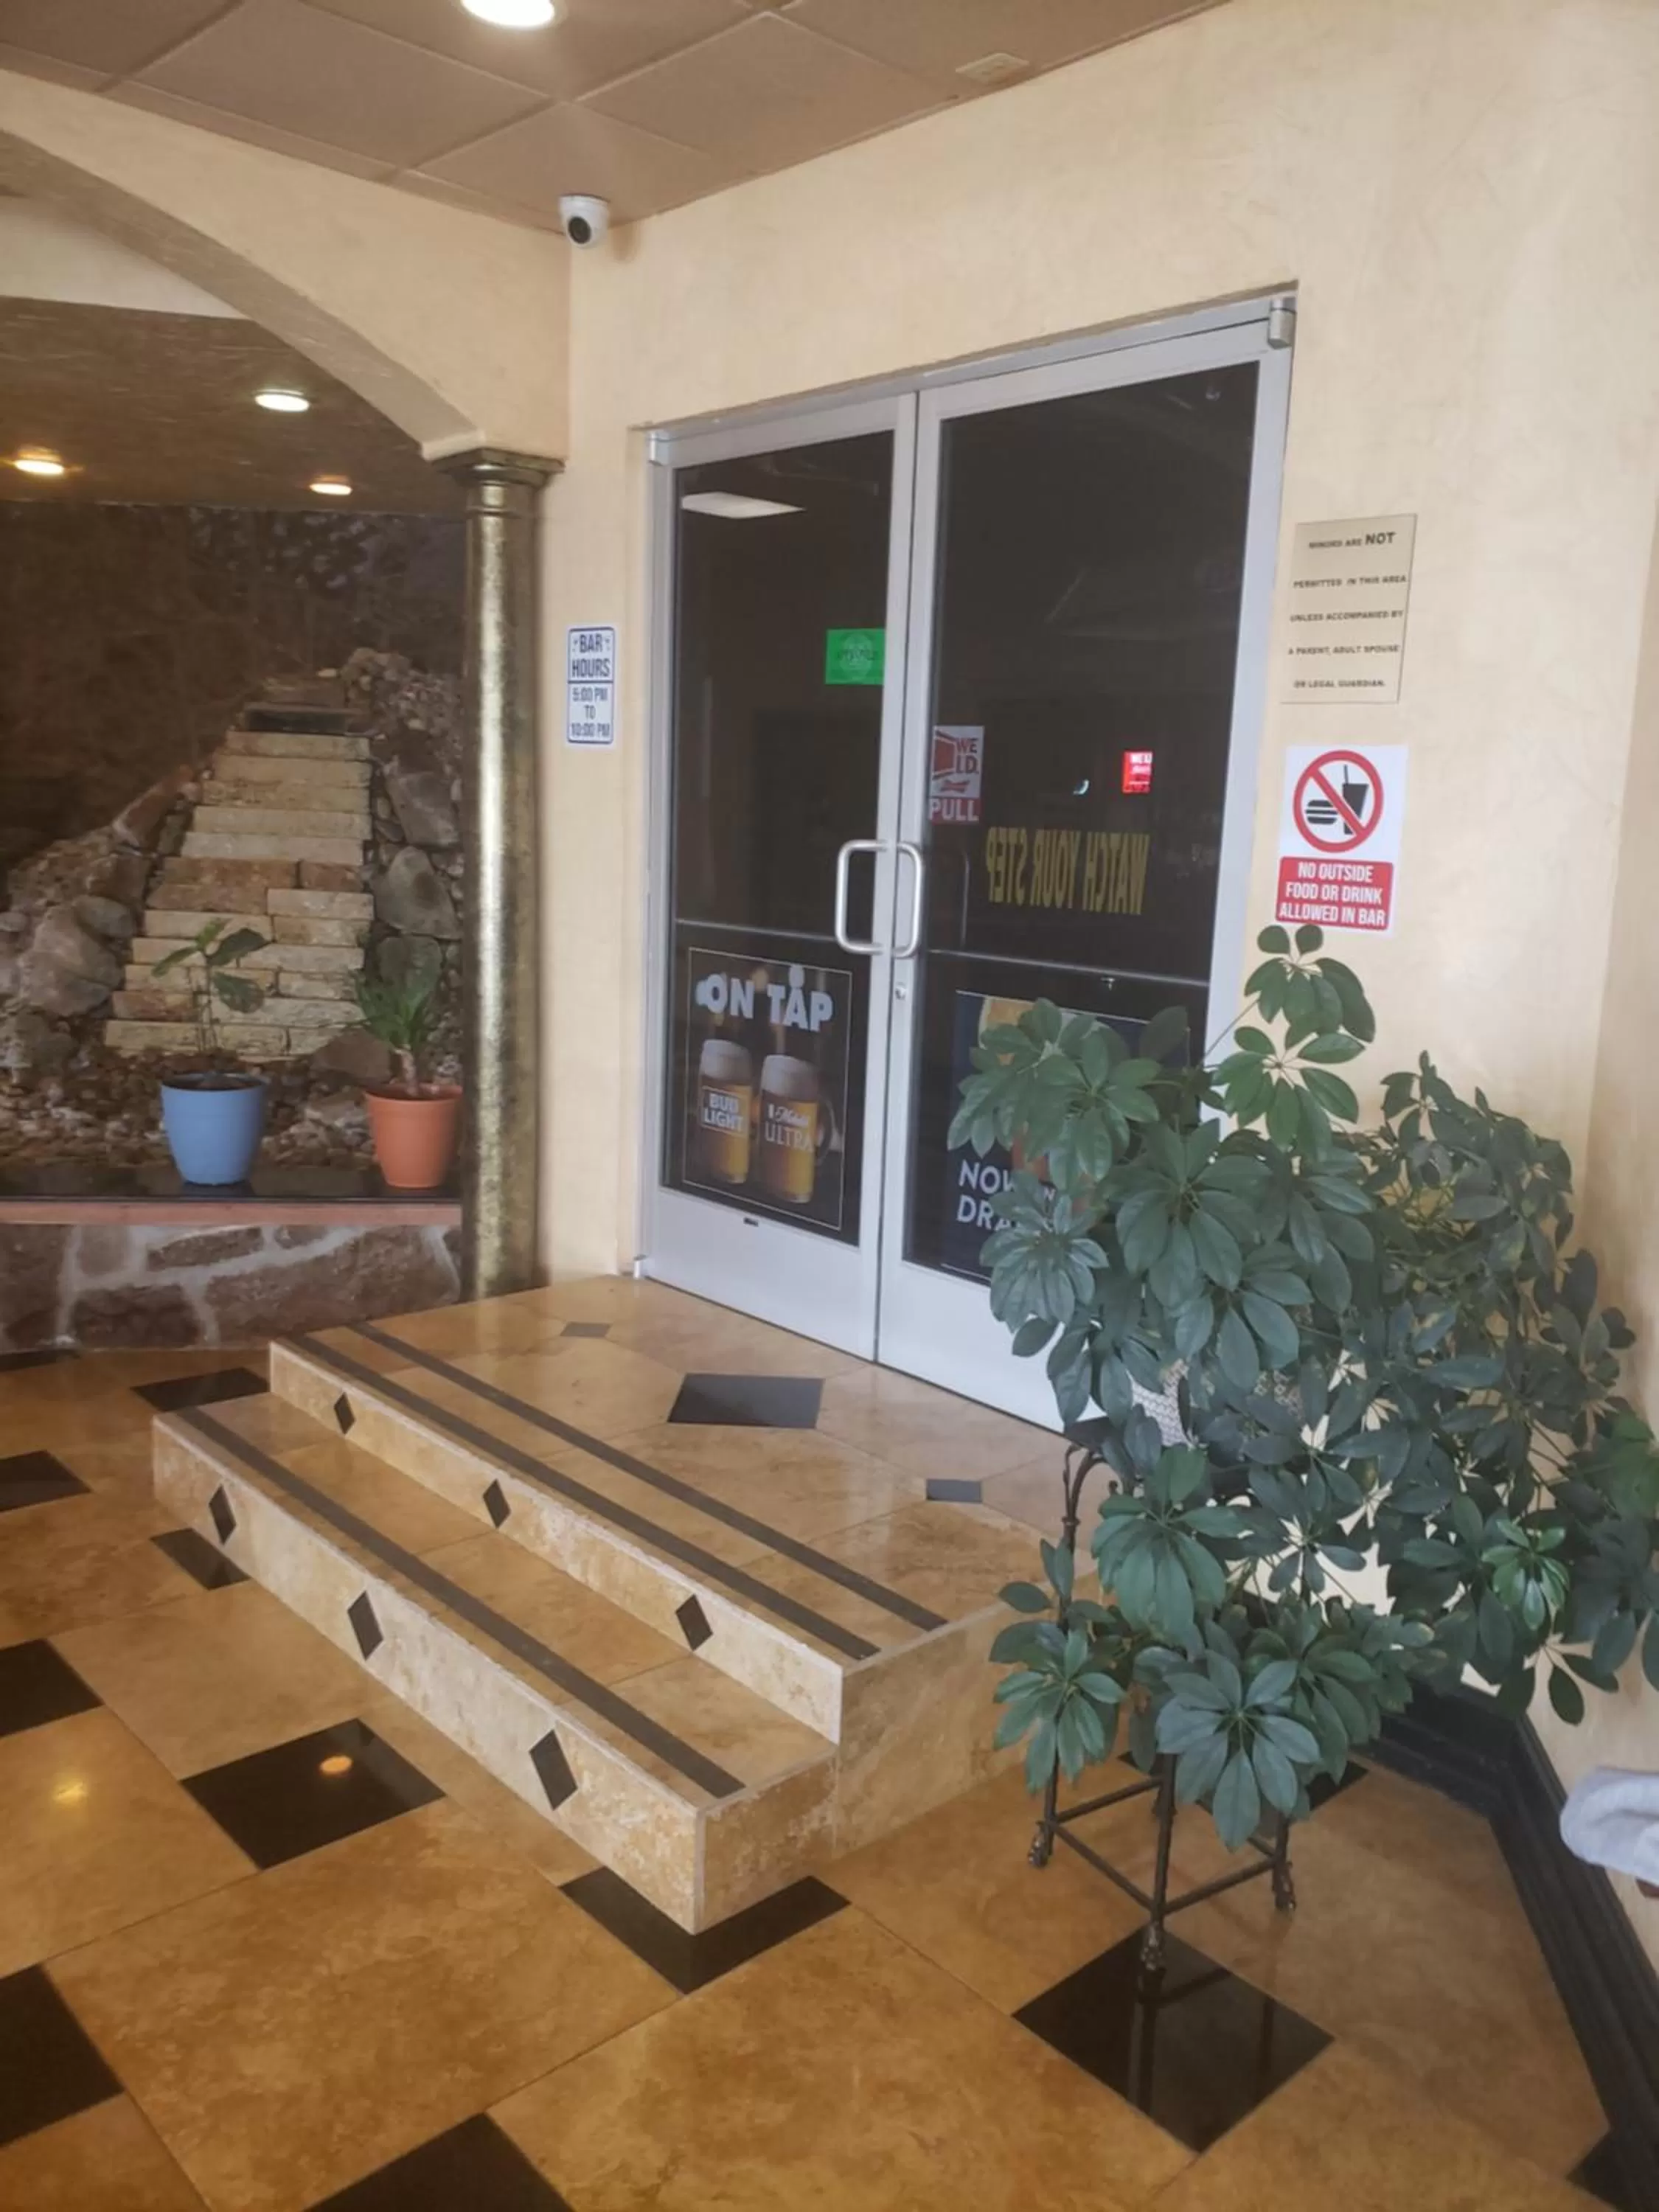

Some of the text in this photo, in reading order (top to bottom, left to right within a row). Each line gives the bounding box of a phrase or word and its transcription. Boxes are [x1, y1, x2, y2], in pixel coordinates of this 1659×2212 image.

[1345, 538, 1362, 547] ARE
[1366, 532, 1397, 545] NOT
[1293, 579, 1342, 588] PERMITTED
[1360, 576, 1379, 585] THIS
[1290, 610, 1403, 622] UNLESS ACCOMPANIED BY
[580, 634, 602, 653] BAR
[1333, 645, 1362, 654] ADULT
[1364, 644, 1400, 653] SPOUSE
[571, 658, 611, 677] HOURS
[572, 686, 608, 701] 5:00 PM
[1294, 680, 1306, 688] OR
[1308, 680, 1335, 688] LEGAL
[584, 705, 596, 720] TO
[597, 723, 610, 737] PM
[929, 799, 979, 821] PULL
[1298, 862, 1374, 882] NO OUTSIDE
[1286, 882, 1382, 904] FOOD OR DRINK
[1279, 902, 1386, 926] ALLOWED IN BAR
[706, 973, 833, 1032] ON TAP
[709, 1093, 739, 1113] BUD
[704, 1108, 743, 1131] LIGHT
[765, 1121, 815, 1152] ULTRA
